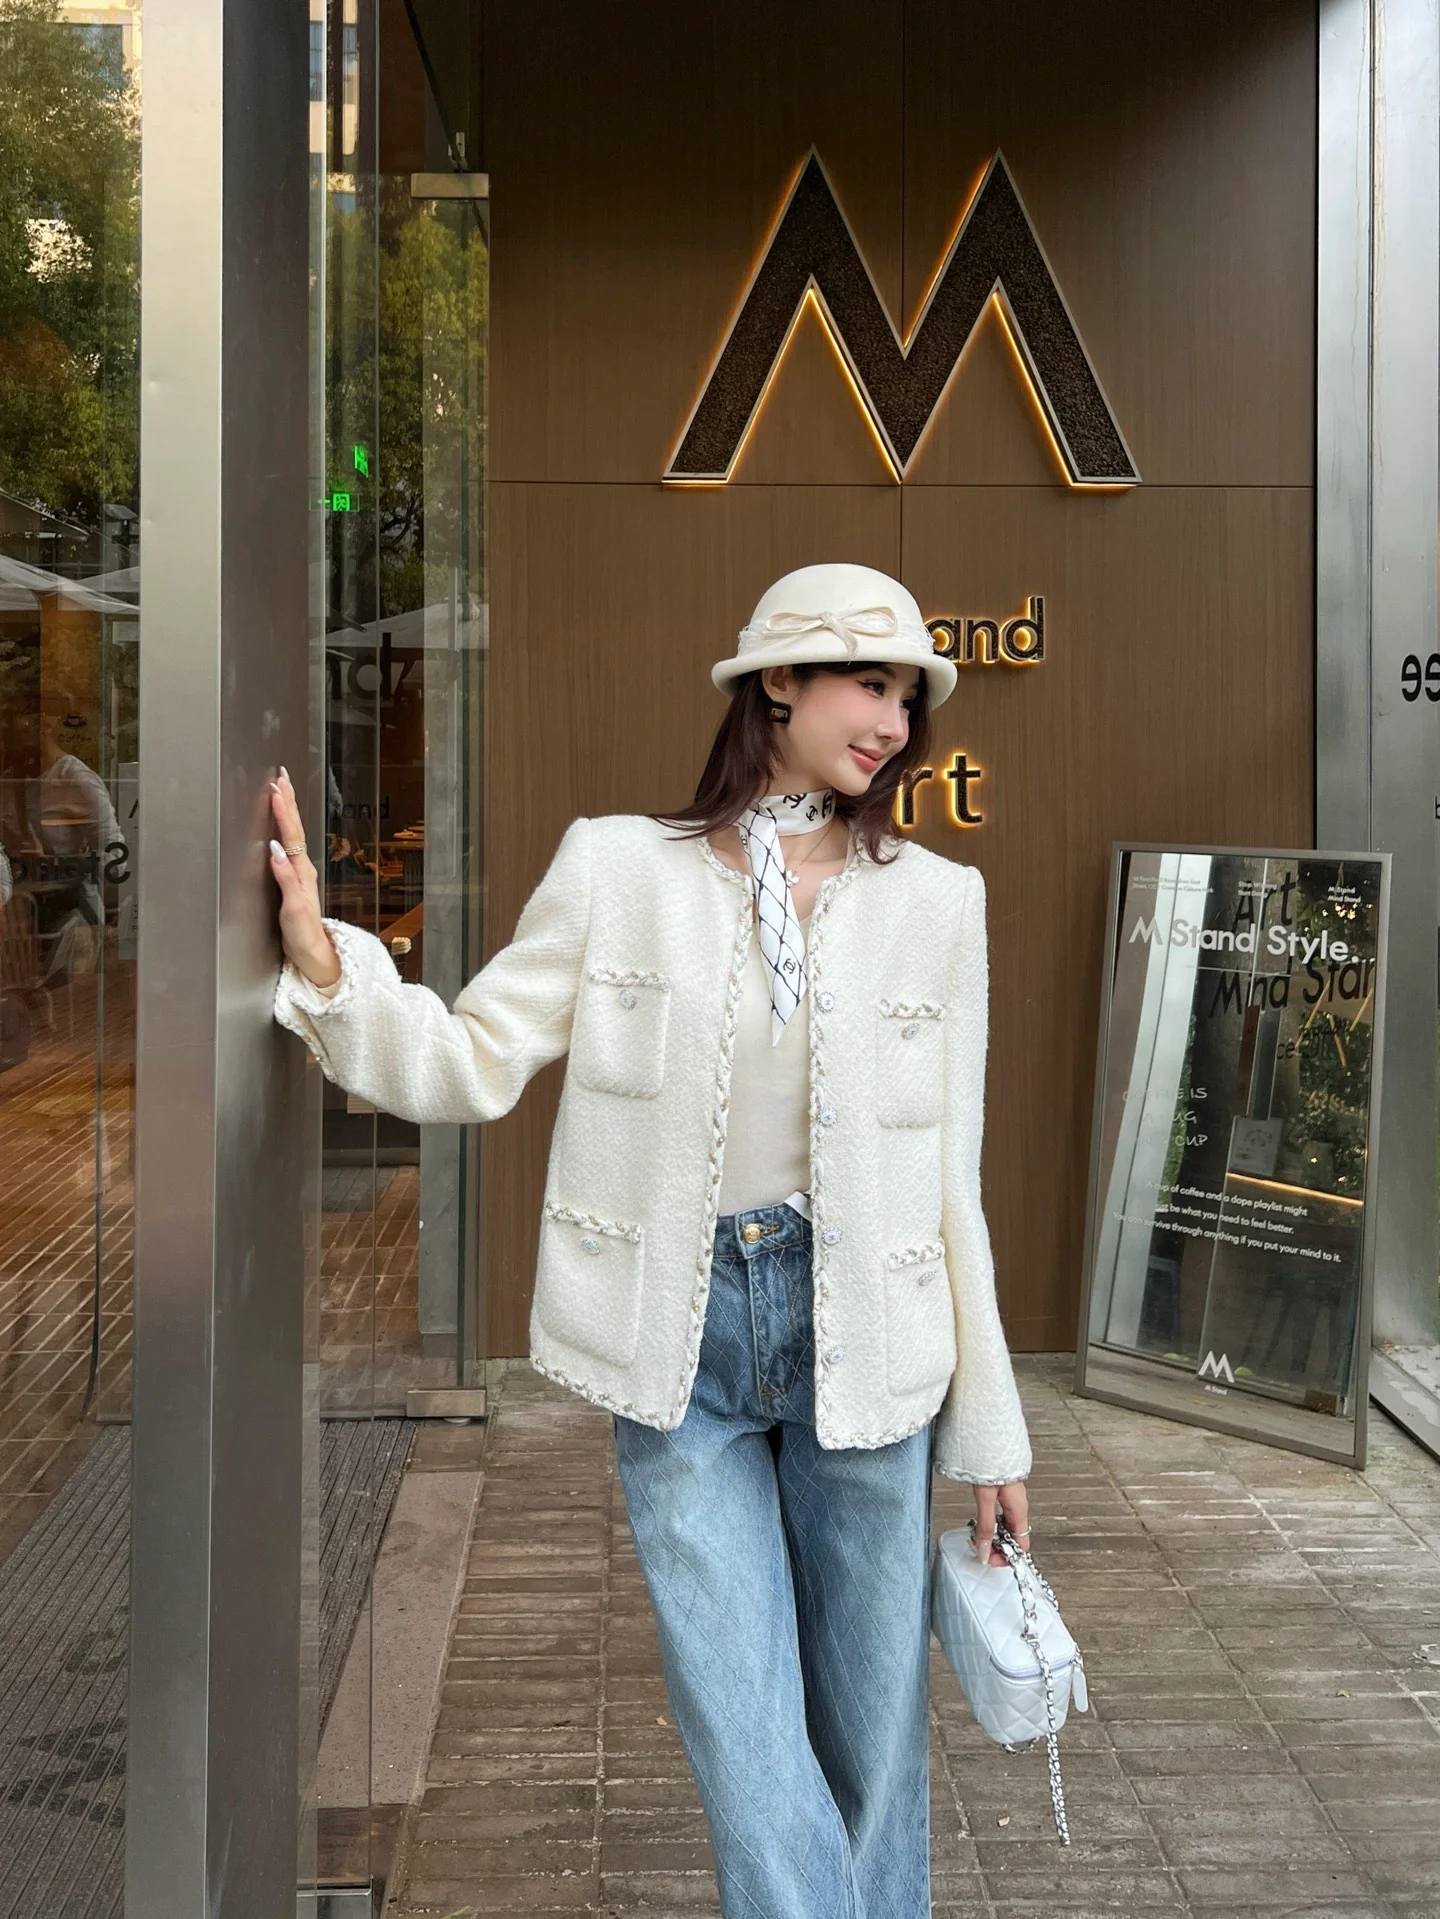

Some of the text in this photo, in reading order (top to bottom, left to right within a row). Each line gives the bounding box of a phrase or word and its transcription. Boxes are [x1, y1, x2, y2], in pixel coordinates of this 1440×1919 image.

[1128, 916, 1359, 965] M Stand Style.
[1190, 1087, 1208, 1099] IS
[1174, 1134, 1209, 1147] CUP
[1171, 1184, 1180, 1193] of
[1180, 1187, 1205, 1198] coffee
[1206, 1192, 1222, 1202] and
[1231, 1195, 1253, 1207] dope
[1254, 1199, 1282, 1212] playlist
[1284, 1204, 1308, 1217] might
[1170, 1203, 1180, 1213] be
[1181, 1206, 1201, 1217] what
[1202, 1210, 1218, 1220] you
[1219, 1214, 1240, 1225] need
[1240, 1218, 1250, 1226] to
[1251, 1218, 1266, 1229] feel
[1268, 1221, 1294, 1234] better.
[1172, 1222, 1203, 1237] through
[1204, 1231, 1240, 1245] anything
[1240, 1235, 1247, 1244] if
[1247, 1239, 1263, 1247] you
[1264, 1241, 1279, 1251] put
[1280, 1244, 1299, 1254] your
[1300, 1247, 1322, 1259] mind
[1323, 1251, 1332, 1261] to
[1333, 1252, 1342, 1263] it.
[1198, 1350, 1235, 1383] M
